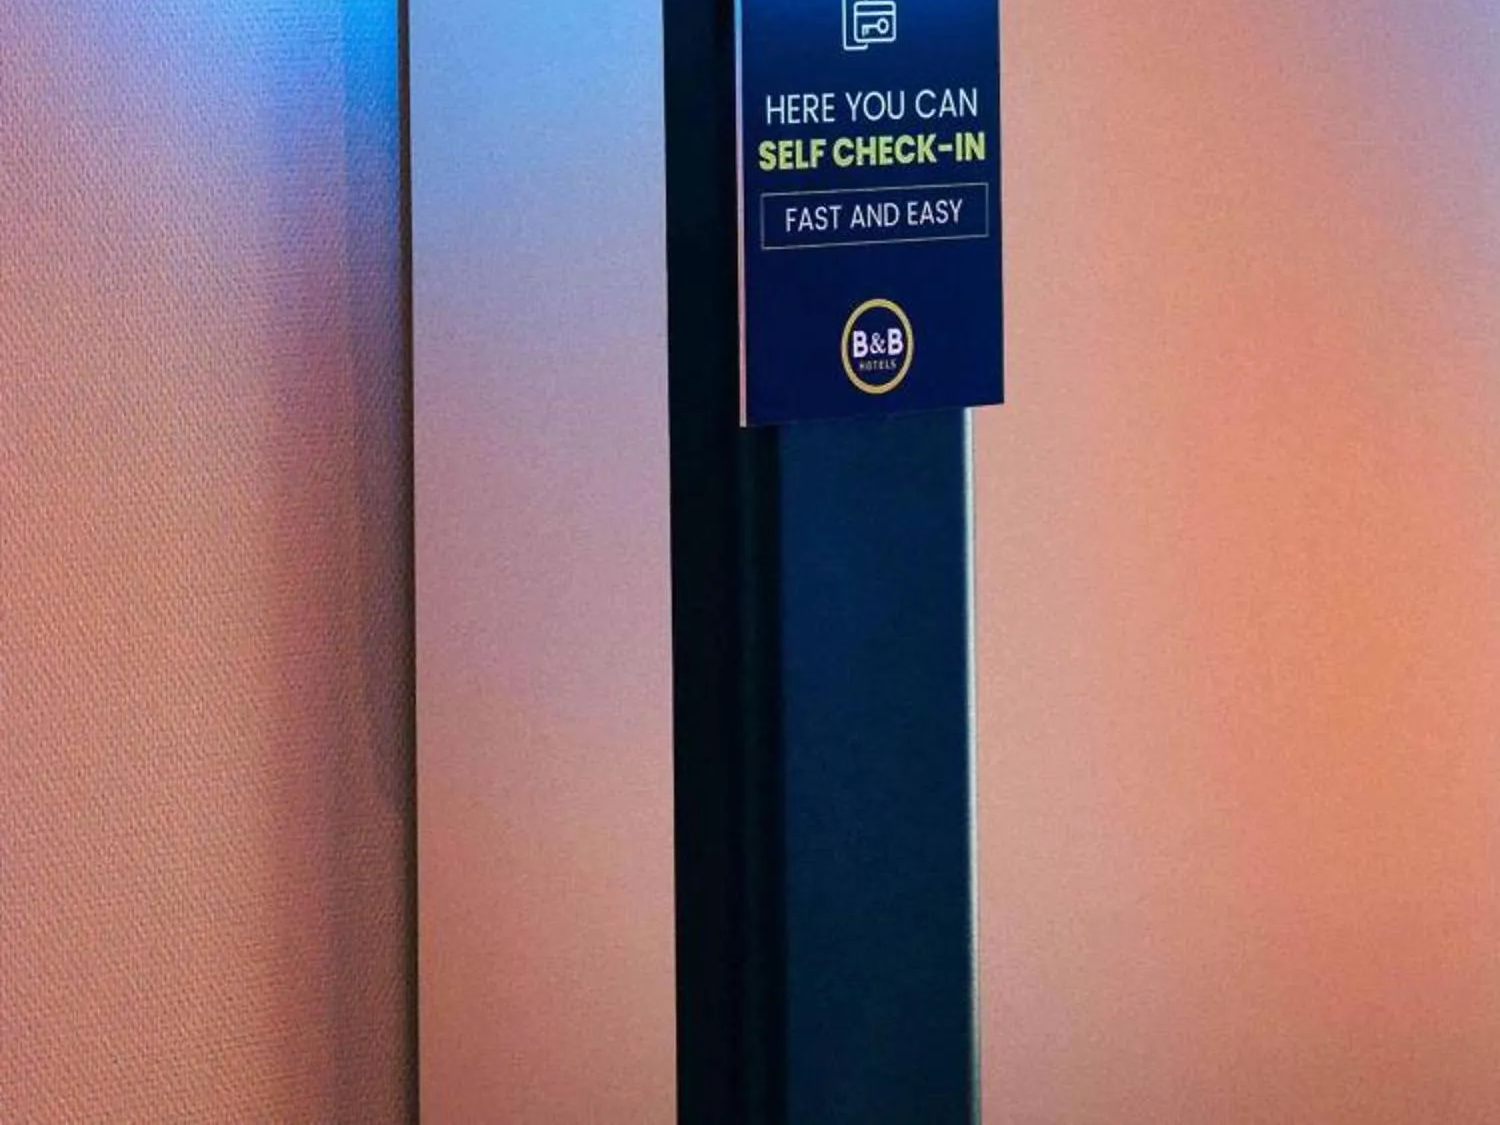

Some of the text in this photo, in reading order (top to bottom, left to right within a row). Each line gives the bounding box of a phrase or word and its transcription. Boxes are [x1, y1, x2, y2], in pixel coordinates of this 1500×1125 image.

[766, 87, 978, 125] HERE YOU CAN
[758, 131, 986, 171] SELF CHECK-IN
[785, 198, 963, 232] FAST AND EASY
[852, 327, 904, 358] B&B
[859, 358, 897, 371] HOTELS
